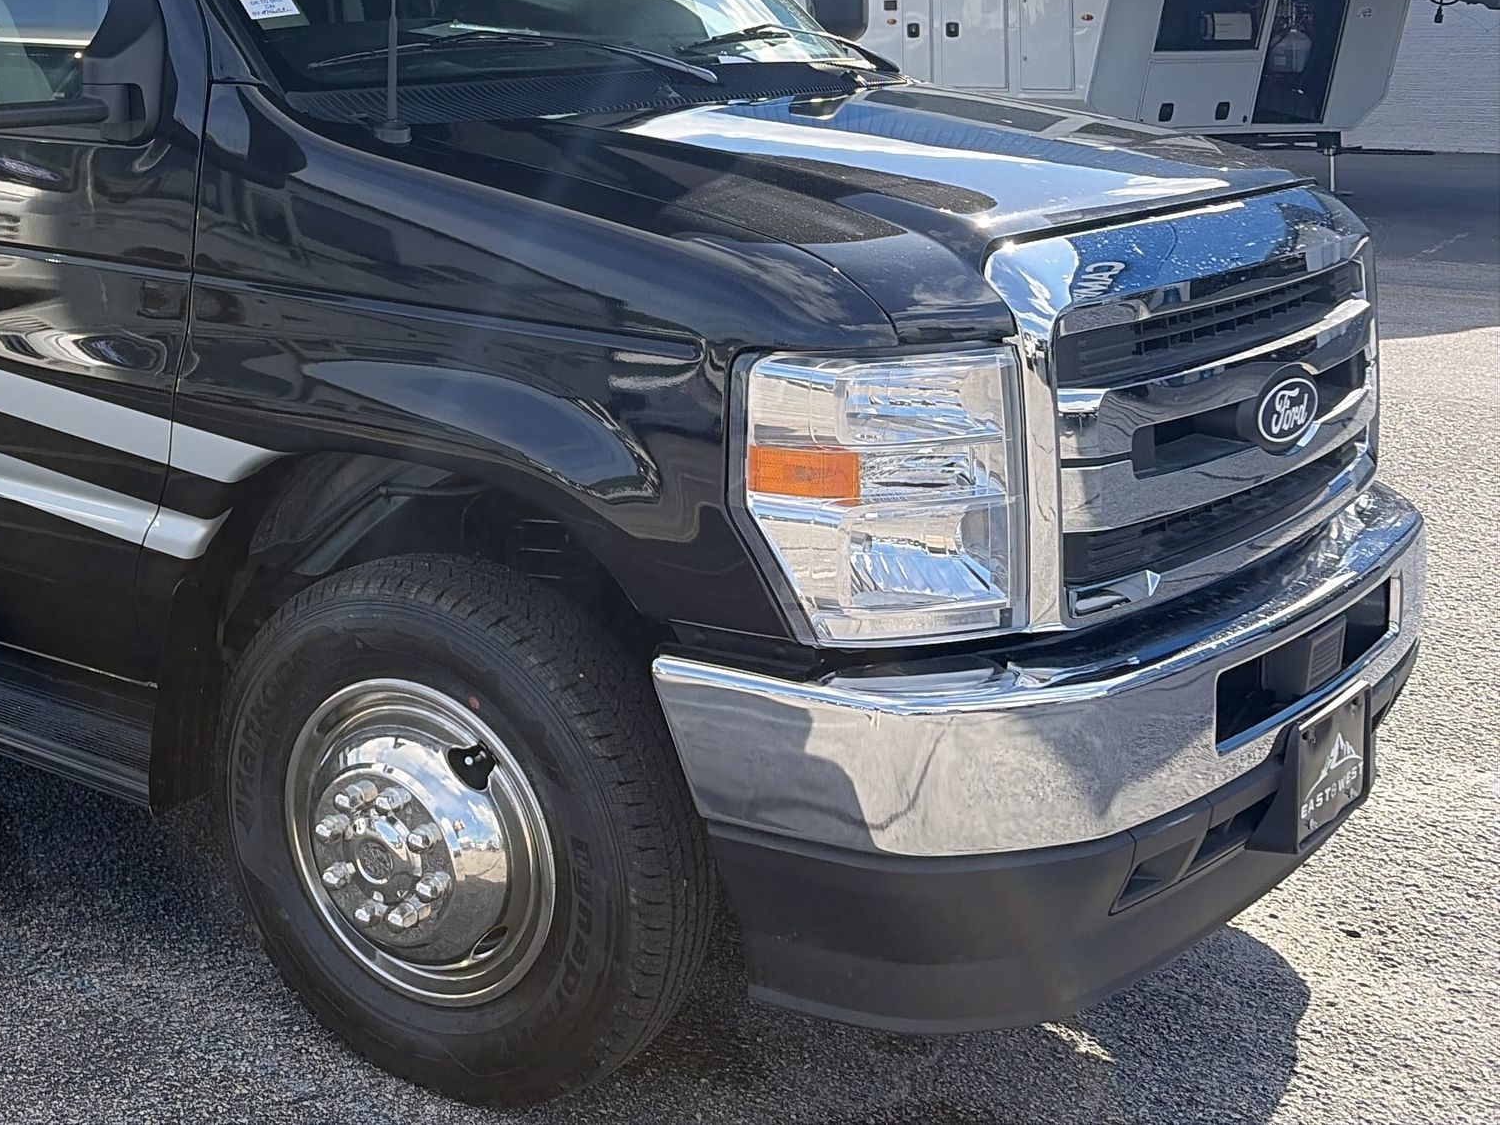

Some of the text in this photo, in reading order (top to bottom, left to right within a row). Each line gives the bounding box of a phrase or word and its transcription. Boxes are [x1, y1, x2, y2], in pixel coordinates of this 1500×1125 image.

[1271, 387, 1308, 434] Ford
[1300, 760, 1364, 819] EAST WEST
